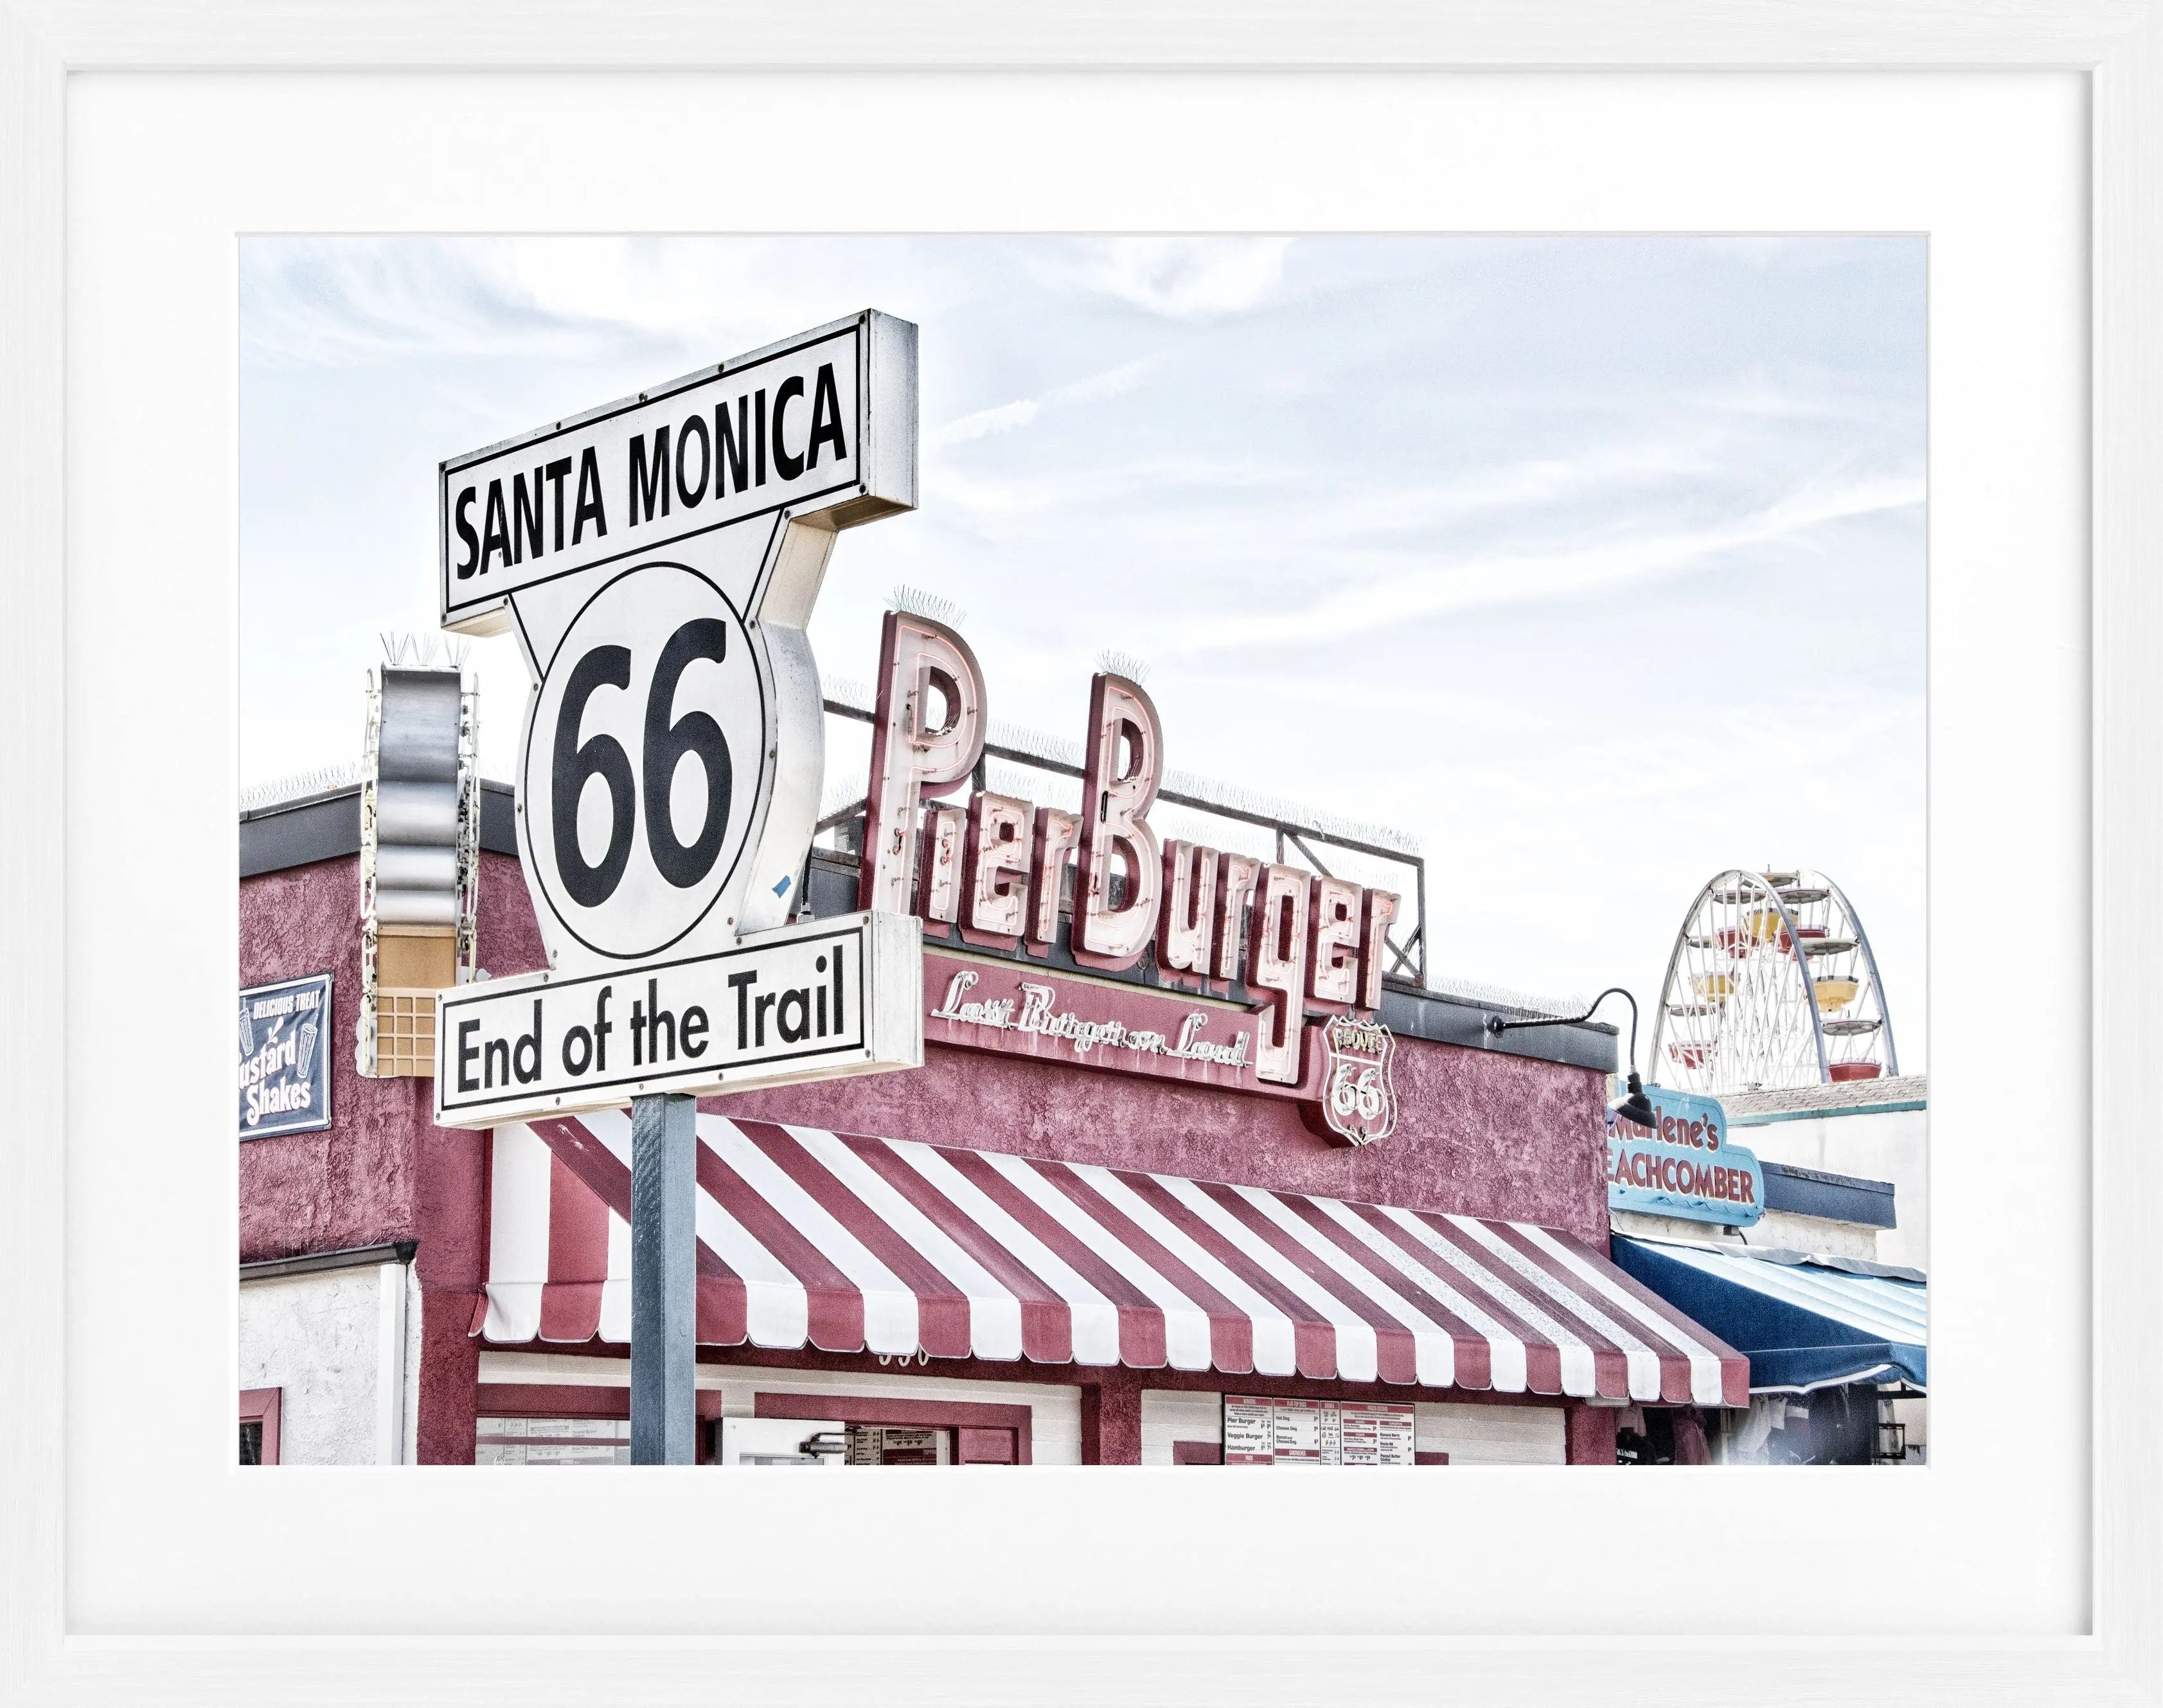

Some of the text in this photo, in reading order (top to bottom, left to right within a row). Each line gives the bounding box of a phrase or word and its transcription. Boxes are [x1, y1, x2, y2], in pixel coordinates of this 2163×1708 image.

[456, 362, 848, 580] SANTA MONICA
[551, 617, 733, 909] 66
[253, 990, 321, 1020] DELICIOUS TREAT
[458, 945, 845, 1093] End of the Trail
[930, 970, 1253, 1068] Last Burger on Land
[240, 1029, 296, 1091] ustard
[1333, 1028, 1383, 1054] ROUTE
[247, 1075, 312, 1126] Shakes
[1333, 1063, 1385, 1121] 66
